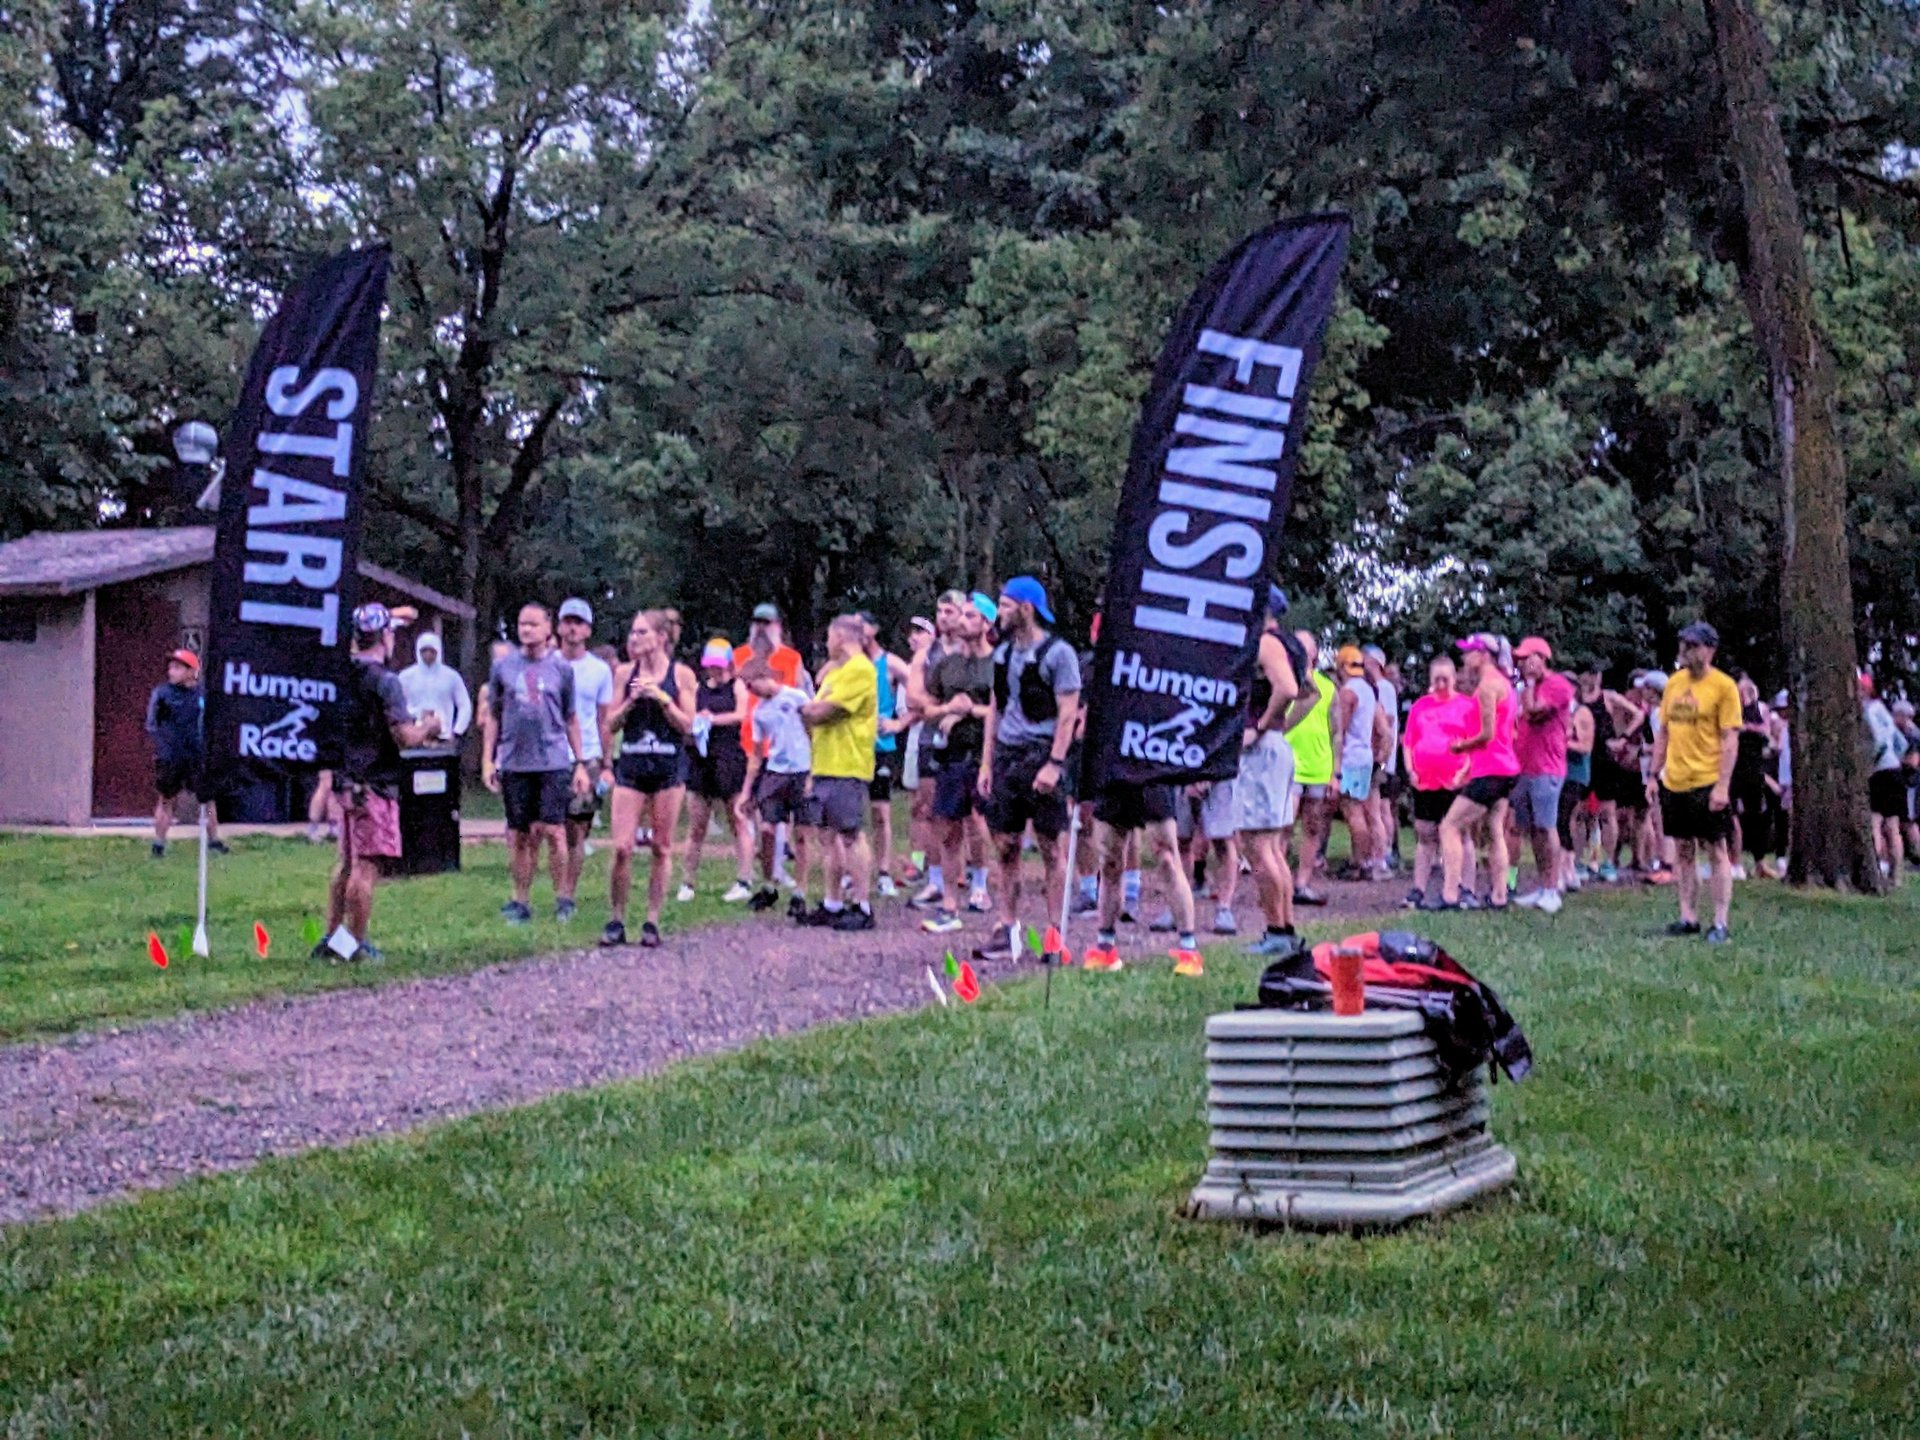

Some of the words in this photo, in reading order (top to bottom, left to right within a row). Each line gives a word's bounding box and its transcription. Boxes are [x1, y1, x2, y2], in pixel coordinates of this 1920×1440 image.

[240, 365, 359, 647] START
[1134, 328, 1304, 647] FINISH
[224, 662, 336, 702] Human
[1112, 651, 1237, 706] Human
[239, 723, 317, 761] Race
[1120, 721, 1207, 767] Race
